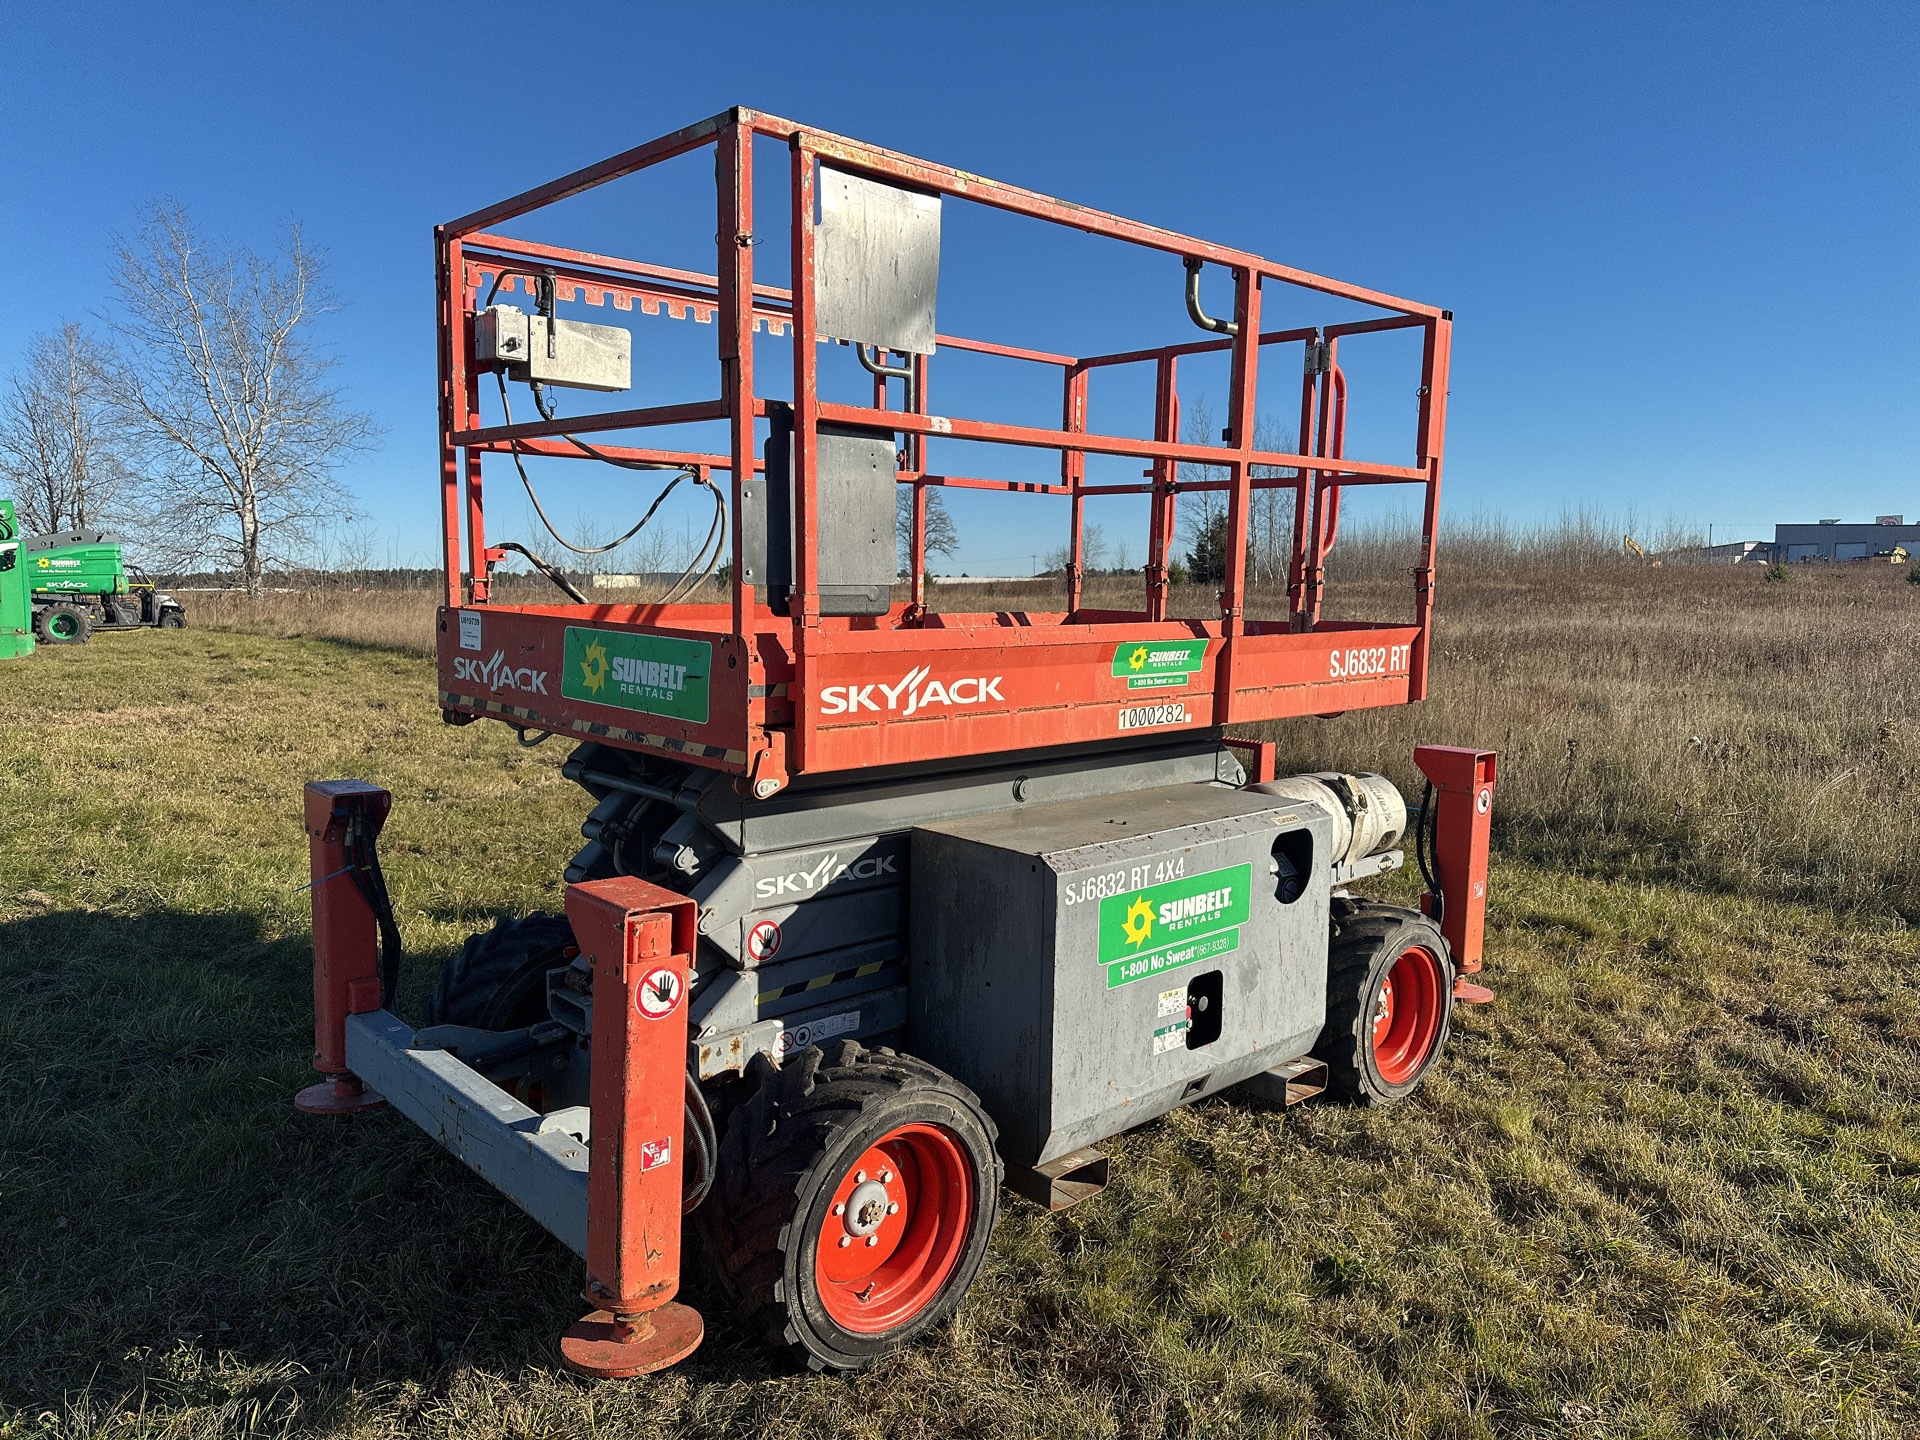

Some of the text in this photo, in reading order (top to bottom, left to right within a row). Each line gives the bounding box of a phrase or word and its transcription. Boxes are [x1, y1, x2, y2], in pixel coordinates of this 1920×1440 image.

[46, 580, 89, 588] SKYJACK
[453, 649, 548, 696] SKYJACK
[612, 656, 687, 691] SUNBELT
[1148, 650, 1191, 663] SUNBELT
[1329, 644, 1410, 678] SJ6832 RT
[620, 683, 674, 701] RENTALS
[820, 664, 1006, 716] SKYJACK
[1120, 704, 1183, 728] 1000282
[756, 853, 898, 898] SKYJACK
[1131, 864, 1151, 890] RT
[1155, 857, 1185, 883] 4X4
[1159, 887, 1232, 925] SUNBELT
[1169, 910, 1221, 932] RENTALS
[1120, 958, 1149, 980] 1-800
[1151, 955, 1165, 971] No
[1166, 946, 1195, 966] Sweat
